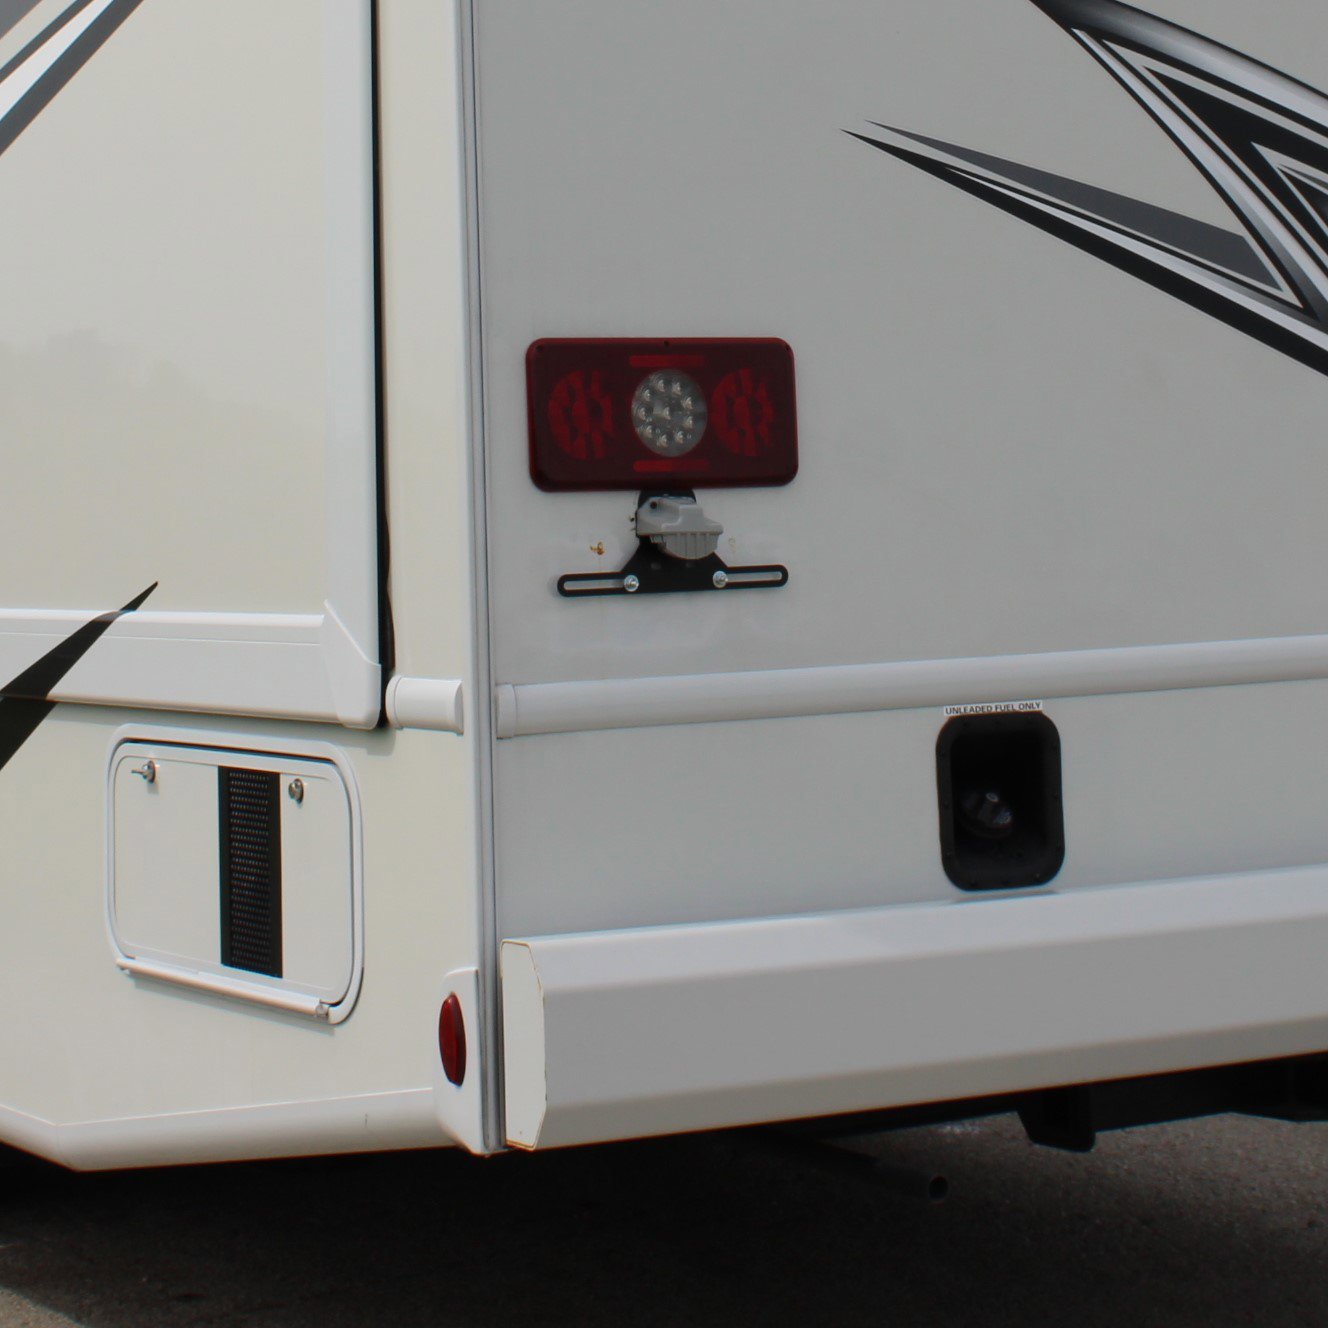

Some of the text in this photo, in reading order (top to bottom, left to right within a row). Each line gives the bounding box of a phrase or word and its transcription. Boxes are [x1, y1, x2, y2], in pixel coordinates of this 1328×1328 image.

[945, 702, 1041, 715] UNLEADED FUEL ONLY
